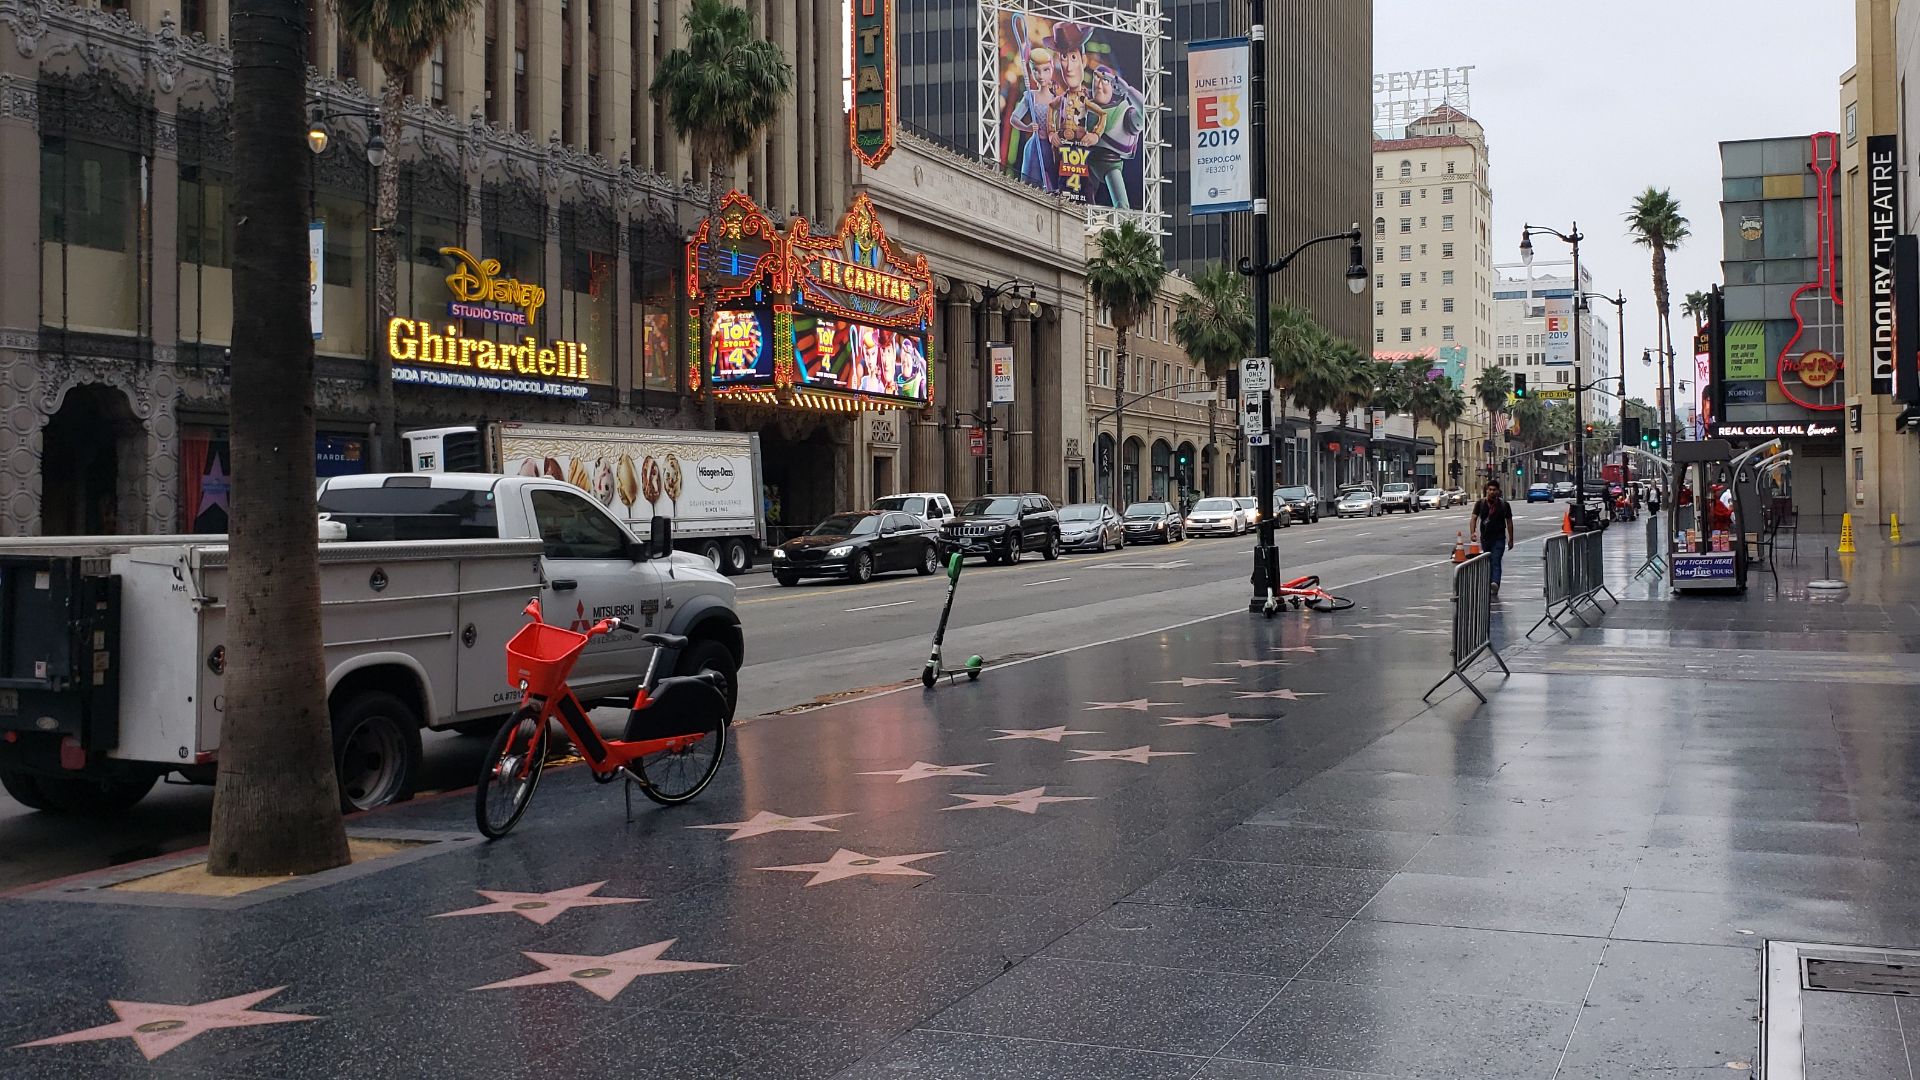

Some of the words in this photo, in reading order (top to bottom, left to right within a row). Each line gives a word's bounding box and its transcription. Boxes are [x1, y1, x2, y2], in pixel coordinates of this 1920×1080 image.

[1195, 78, 1217, 89] JUNE
[1220, 76, 1242, 86] 11-13
[1197, 95, 1240, 130] E3
[1374, 99, 1439, 120] TEL
[1198, 128, 1240, 148] 2019
[1059, 146, 1090, 166] TOY
[1197, 155, 1242, 165] E3EXPO.COM
[1062, 165, 1087, 174] STORY
[1066, 173, 1081, 192] 4
[1873, 149, 1894, 258] THEATRE
[821, 259, 841, 284] EL
[452, 303, 492, 320] STUDIO
[492, 309, 526, 325] STORE
[719, 321, 754, 339] TOY
[816, 327, 836, 346] TOY
[1549, 331, 1568, 339] 2019
[388, 317, 590, 379] Ghirardelli
[729, 348, 744, 367] 4
[821, 354, 831, 370] 4
[1783, 357, 1817, 373] Hard
[392, 367, 419, 382] SODA
[420, 370, 477, 388] FOUNTAIN
[476, 375, 501, 390] AND
[501, 378, 561, 395] CHOCOLATE
[562, 385, 588, 398] SHOP
[1718, 427, 1744, 435] REAL
[1745, 426, 1776, 435] GOLD.
[1777, 425, 1805, 434] REAL
[317, 453, 359, 461] RARDE
[699, 467, 733, 479] Häagen-Dazs
[593, 604, 635, 618] MITSUBISHI
